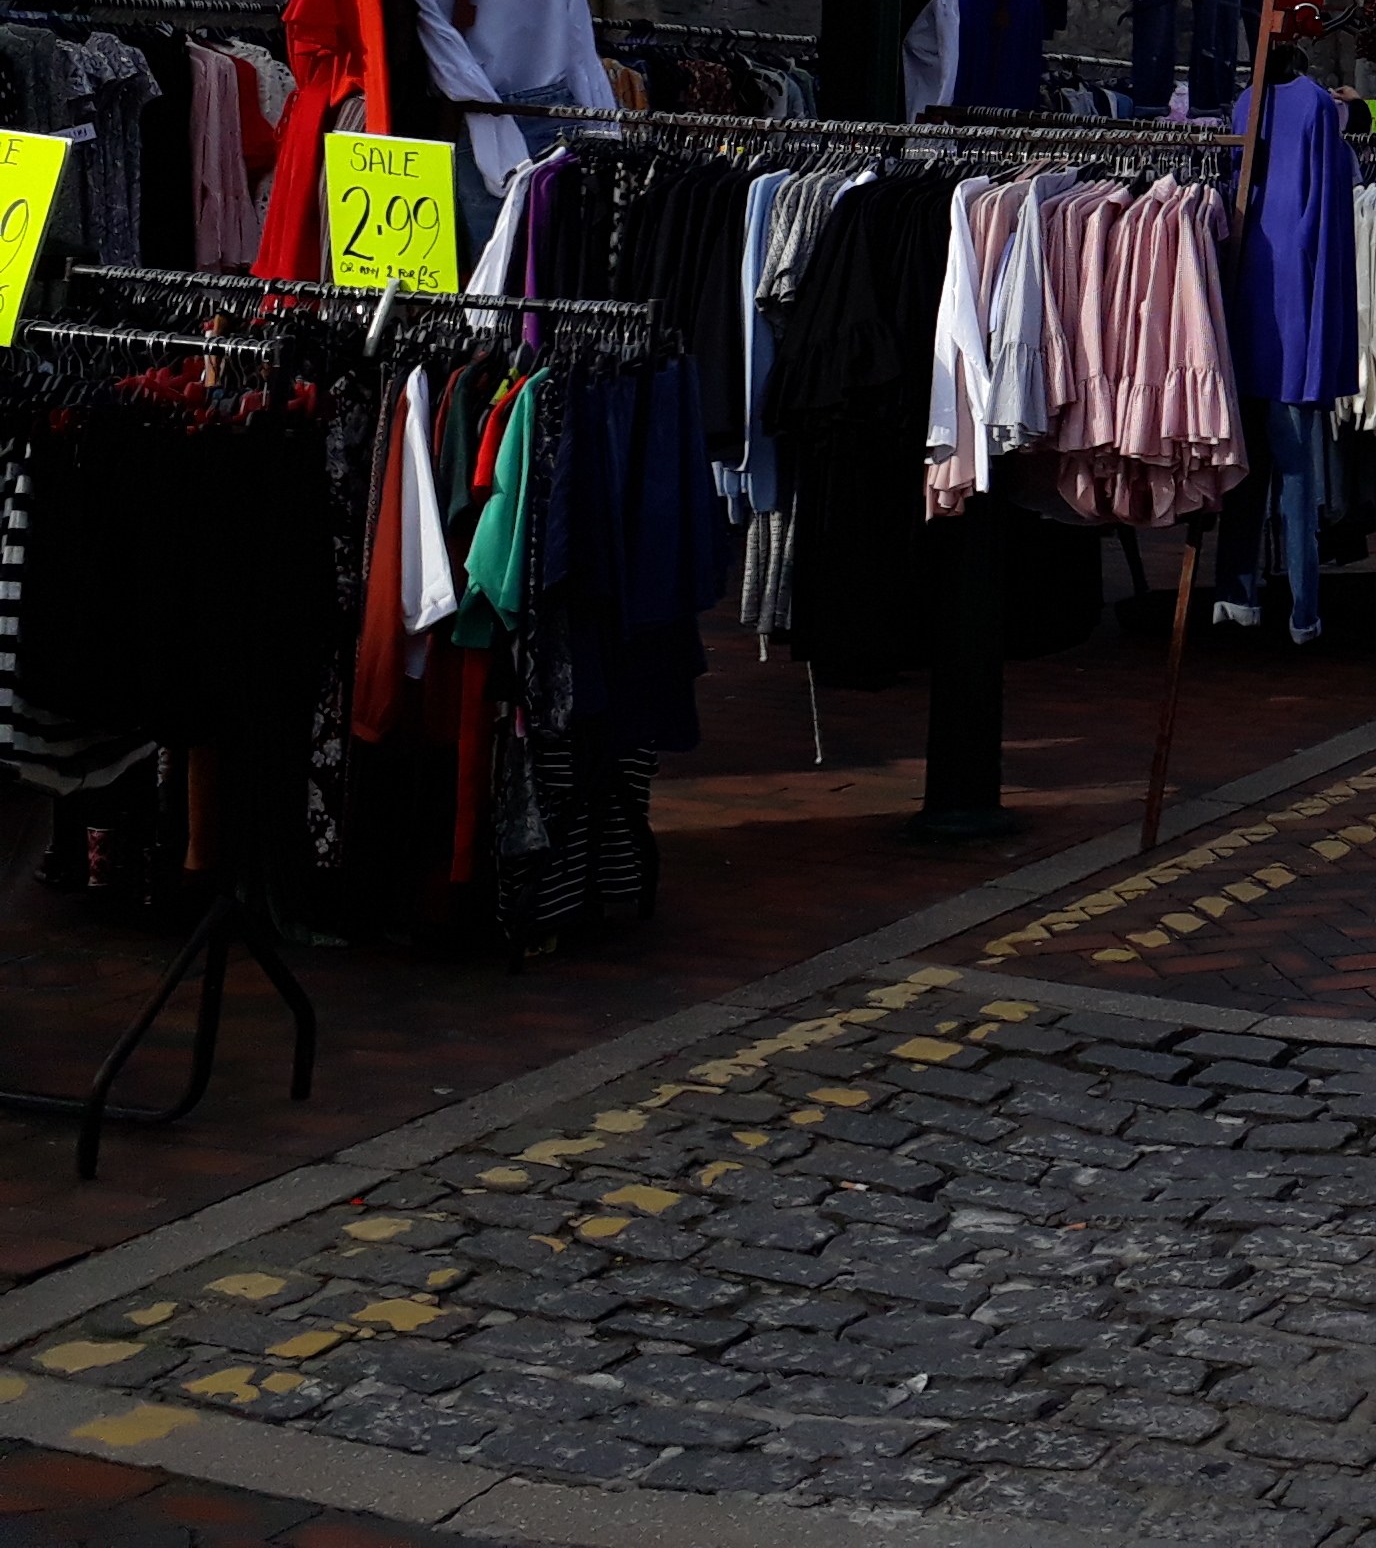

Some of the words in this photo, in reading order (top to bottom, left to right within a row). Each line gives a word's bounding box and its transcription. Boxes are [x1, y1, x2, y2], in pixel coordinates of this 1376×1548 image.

[350, 142, 420, 178] SALE
[341, 185, 440, 261] 2.99
[417, 265, 440, 290] £5
